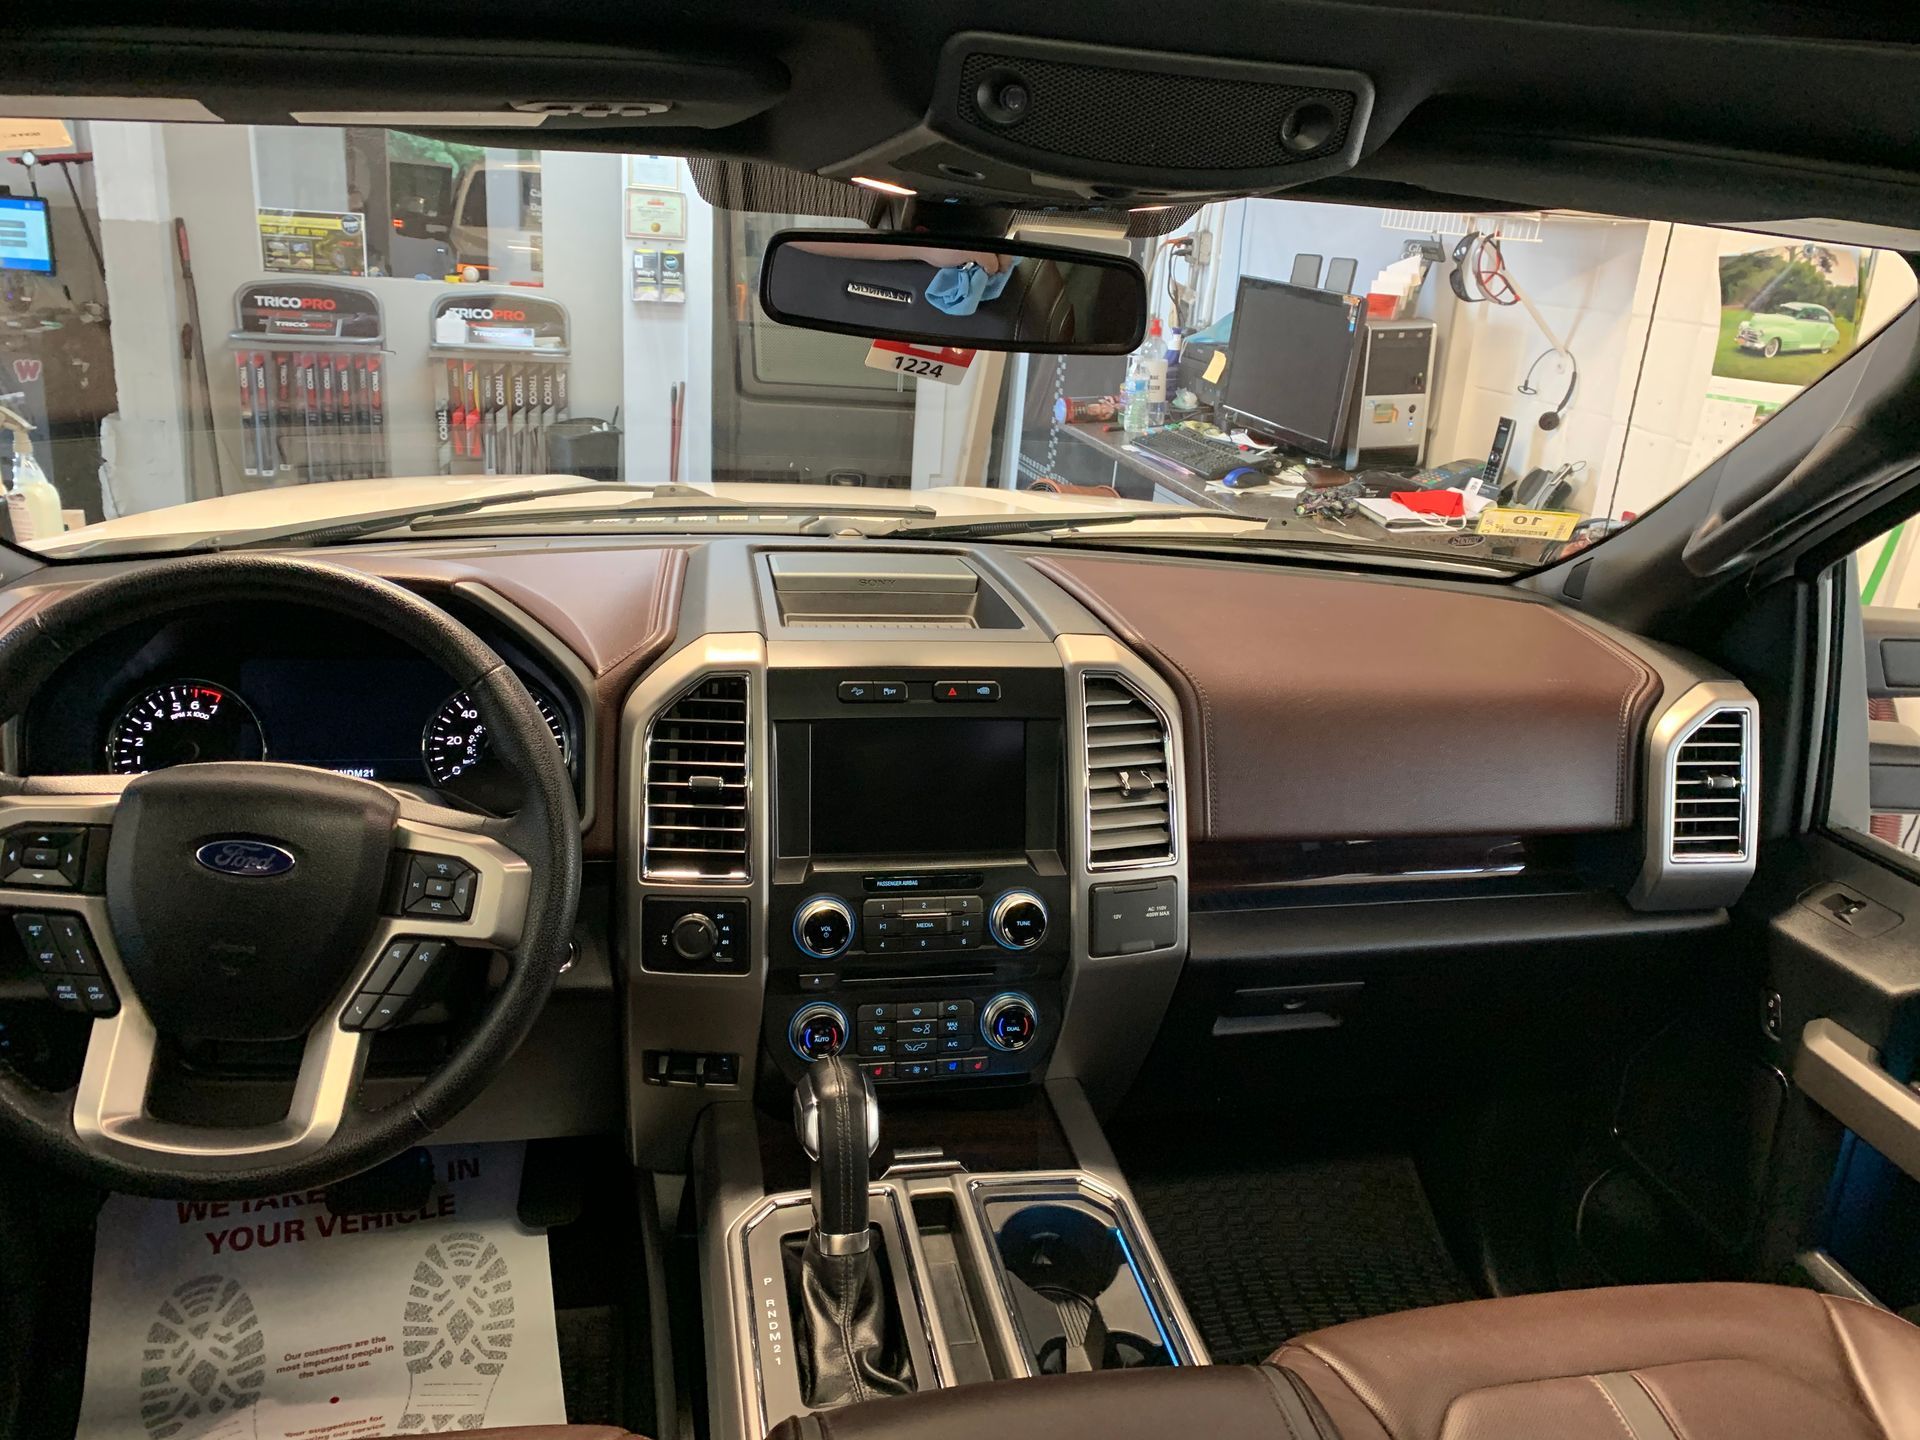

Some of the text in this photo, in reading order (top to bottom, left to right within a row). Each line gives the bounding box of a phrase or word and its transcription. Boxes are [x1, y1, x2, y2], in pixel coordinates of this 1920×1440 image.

[254, 295, 337, 310] TRICOPRO
[895, 356, 944, 378] 1224
[495, 375, 505, 405] TRICO
[515, 376, 524, 406] TRICO
[529, 375, 538, 405] TRICO
[544, 376, 553, 405] TRICO
[438, 411, 448, 440] TRICO
[858, 578, 897, 588] SONY
[154, 709, 164, 718] 4
[172, 702, 181, 711] 5
[190, 701, 200, 710] 6
[209, 705, 218, 714] 7
[461, 709, 478, 719] 40
[170, 712, 186, 721] RPM
[193, 712, 210, 720] 1000
[143, 722, 153, 731] 3
[135, 738, 143, 746] 2
[446, 736, 463, 745] 20
[332, 769, 374, 778] NDM21
[214, 843, 277, 870] Ford
[447, 1157, 480, 1183] IN
[205, 1216, 305, 1255] YOUR
[284, 1336, 387, 1362] Our customers are the
[276, 1344, 394, 1374] most important people in
[298, 1371, 314, 1379] the
[317, 1365, 344, 1376] world
[346, 1362, 356, 1370] to
[308, 1418, 367, 1435] suggestions
